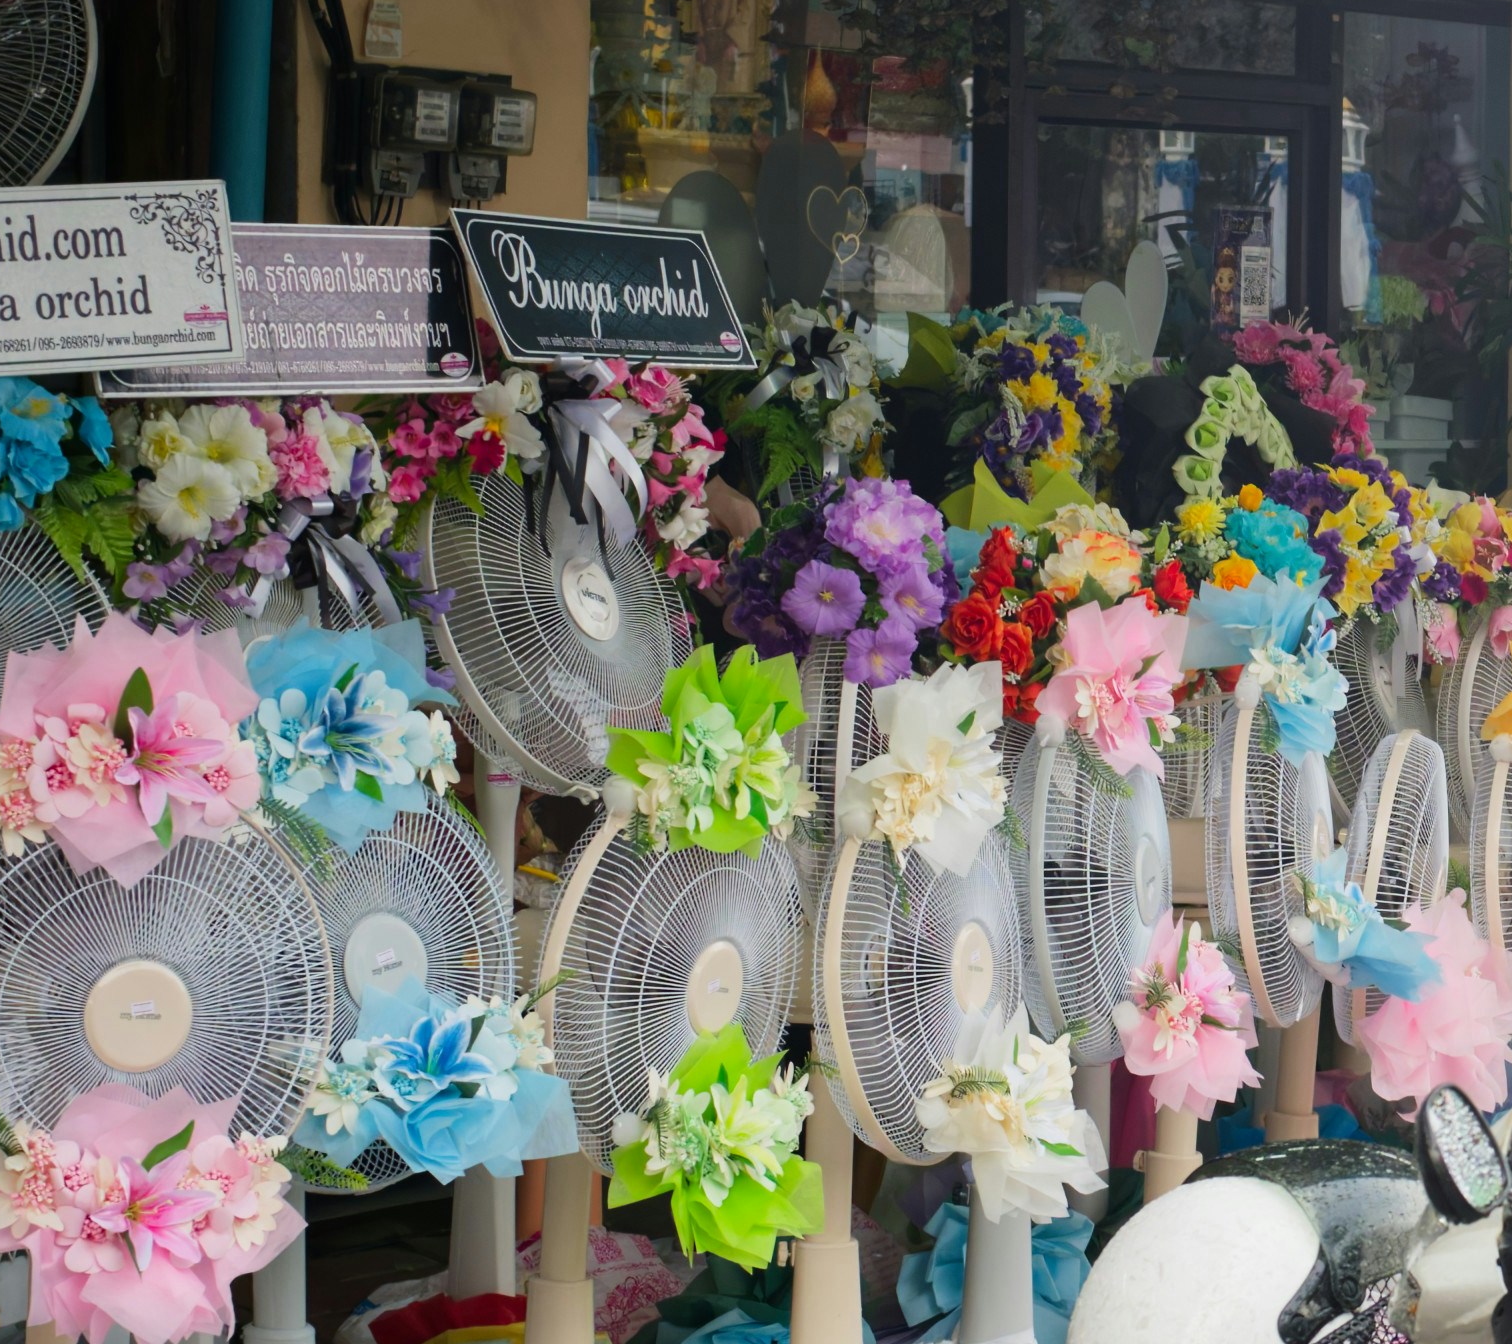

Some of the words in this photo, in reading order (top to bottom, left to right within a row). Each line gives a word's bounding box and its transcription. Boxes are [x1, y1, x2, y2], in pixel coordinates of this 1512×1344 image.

[35, 274, 152, 321] orchid
[491, 229, 618, 338] Bunga
[623, 257, 709, 319] orchid
